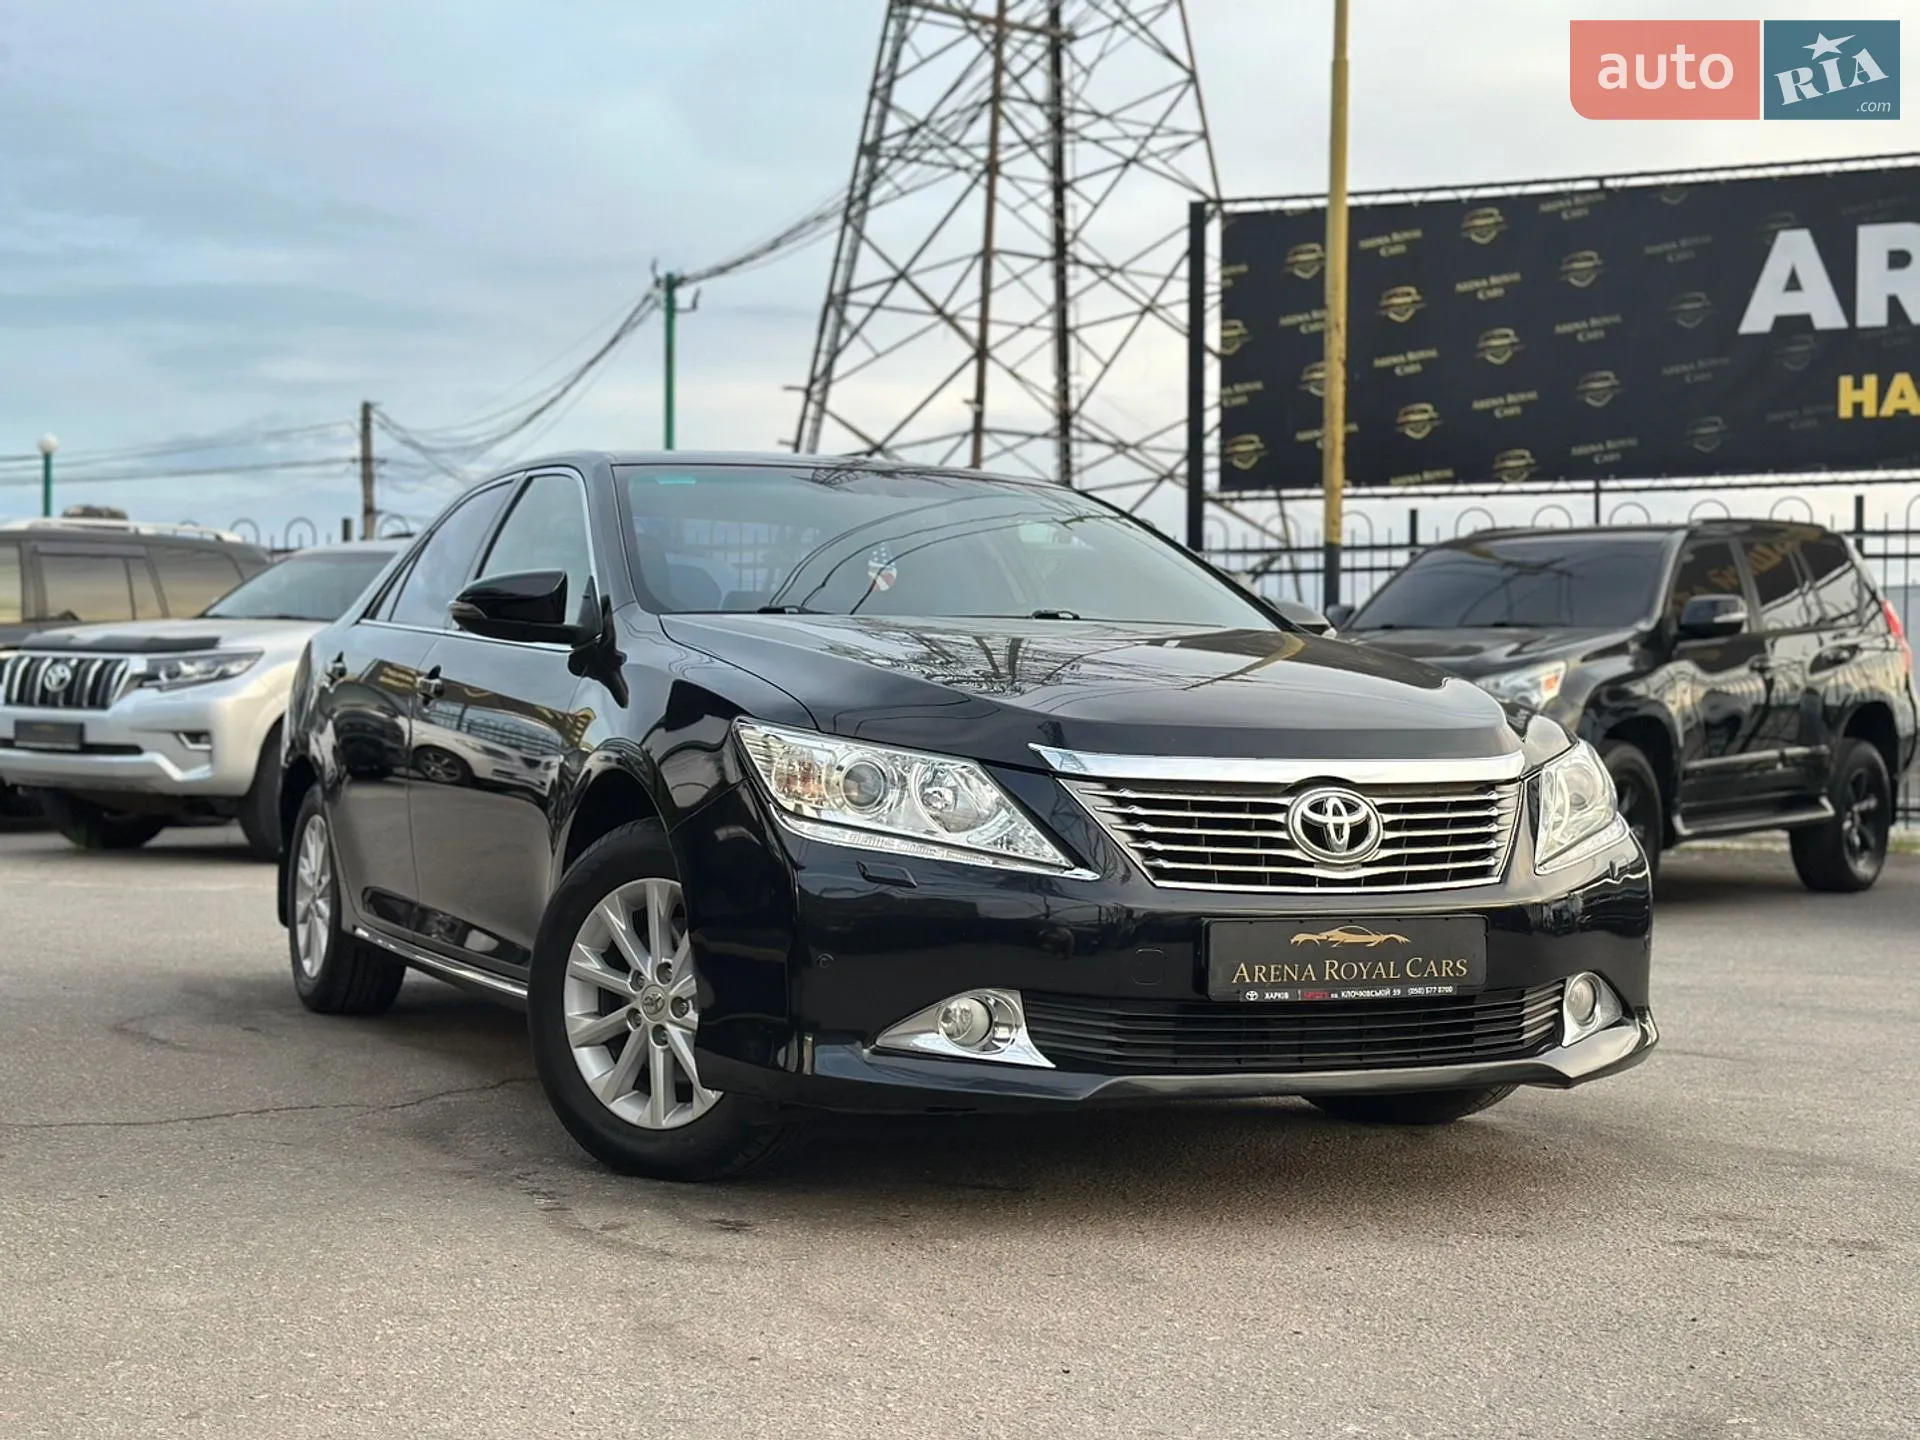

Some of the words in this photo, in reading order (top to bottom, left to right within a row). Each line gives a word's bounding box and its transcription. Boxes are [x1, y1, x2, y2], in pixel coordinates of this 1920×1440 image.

[1738, 222, 1920, 335] AR
[1232, 962, 1316, 984] ARENA
[1324, 959, 1400, 981] ROYAL
[1405, 957, 1468, 978] CARS
